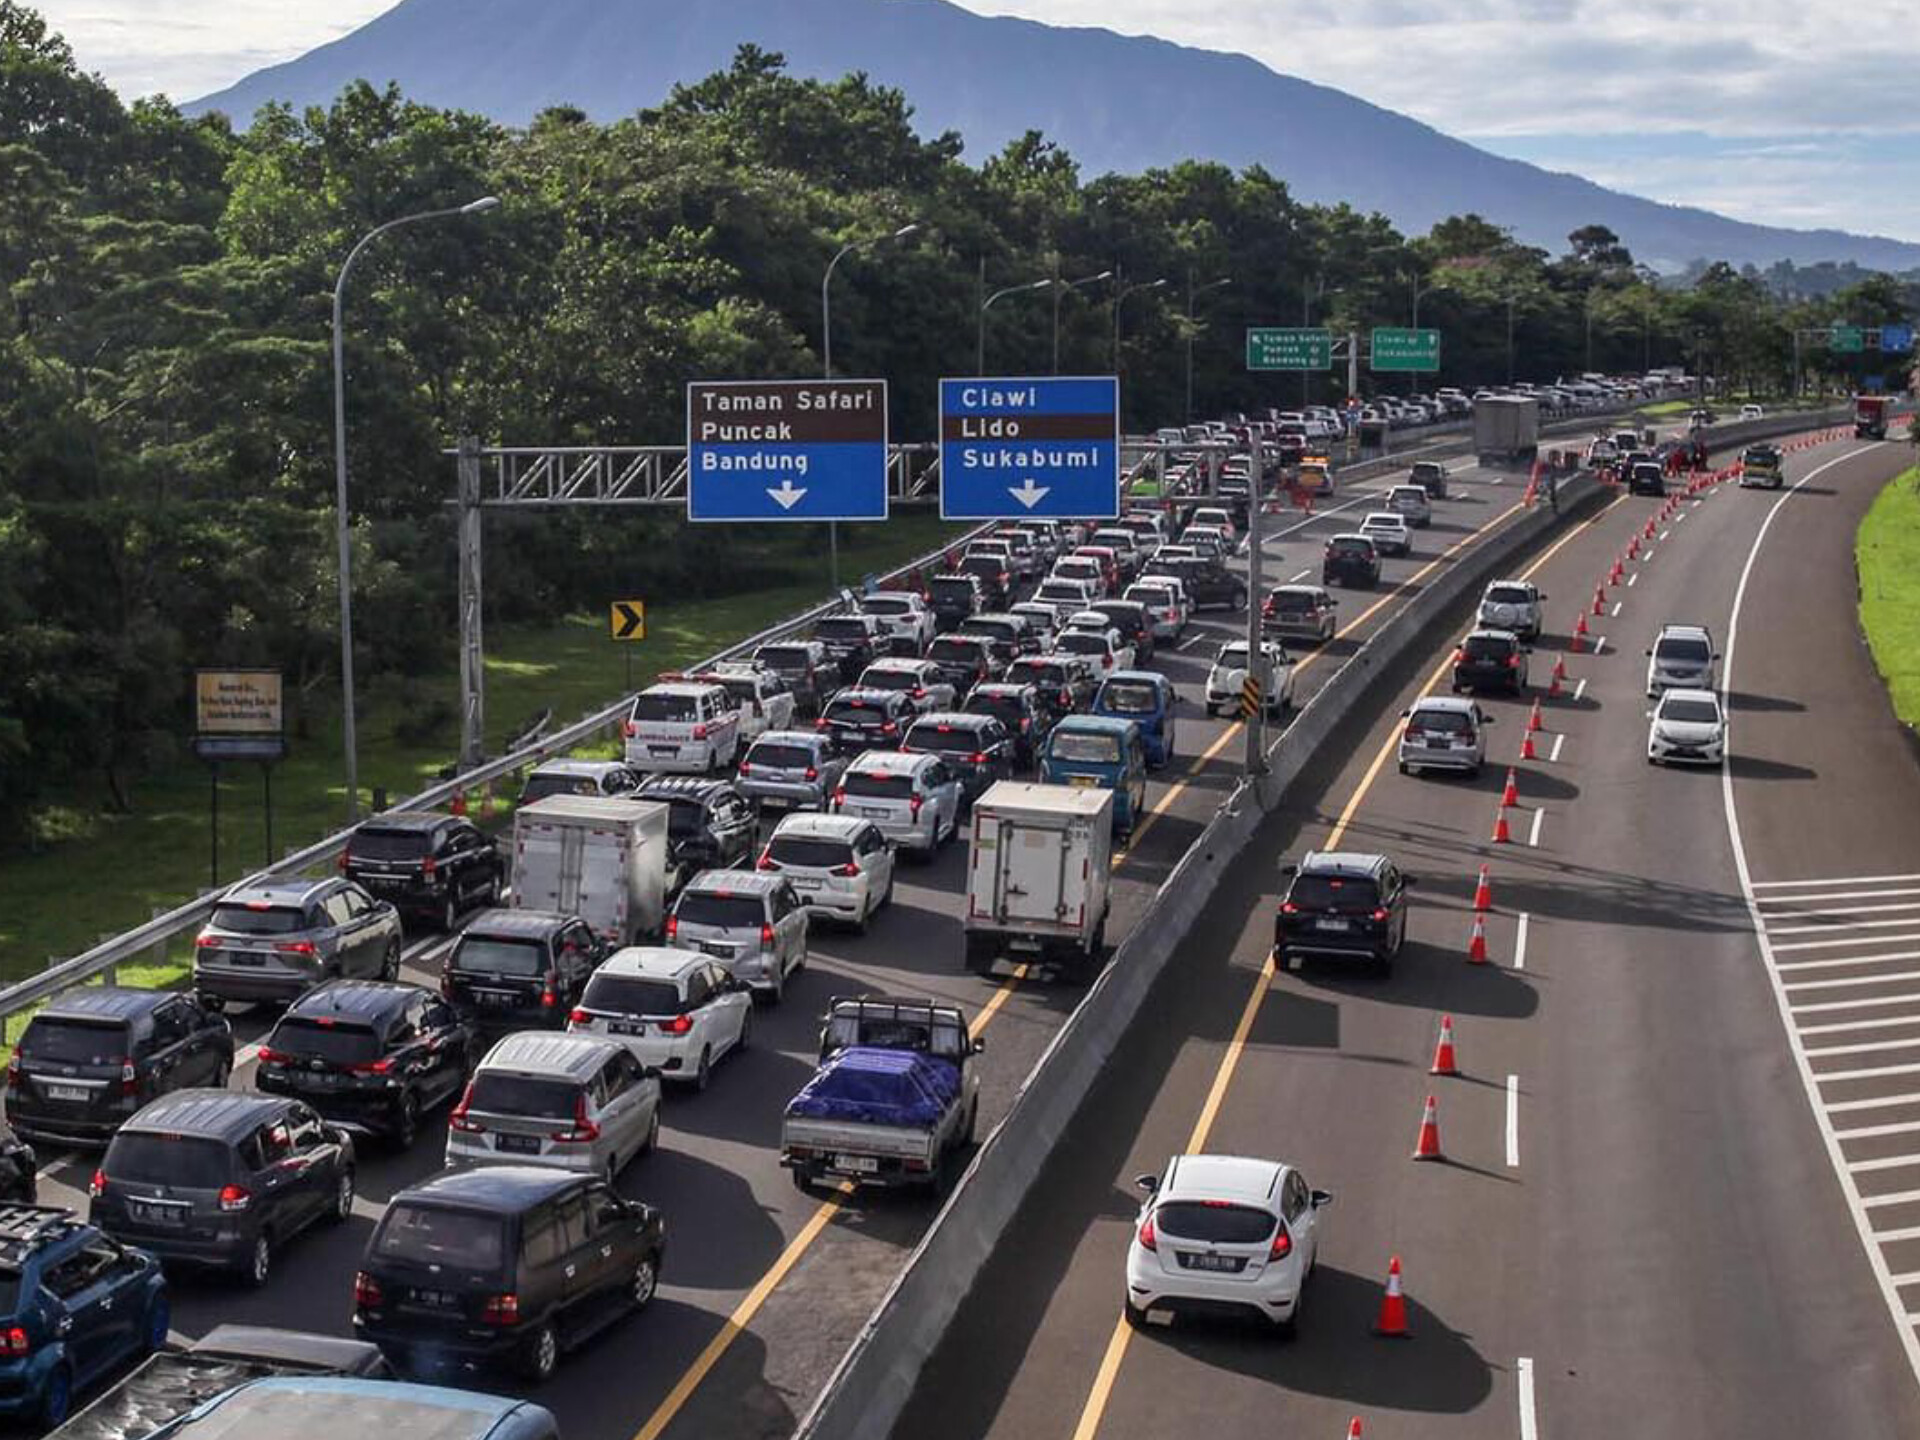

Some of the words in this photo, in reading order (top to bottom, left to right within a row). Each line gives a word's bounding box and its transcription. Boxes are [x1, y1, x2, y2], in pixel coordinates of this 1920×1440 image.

[702, 392, 782, 411] Taman
[796, 389, 872, 410] Safari
[962, 387, 1036, 407] Ciawi
[702, 421, 792, 441] Puncak
[962, 417, 1019, 437] Lido
[702, 451, 807, 475] Bandung
[963, 447, 1098, 467] Sukabumi
